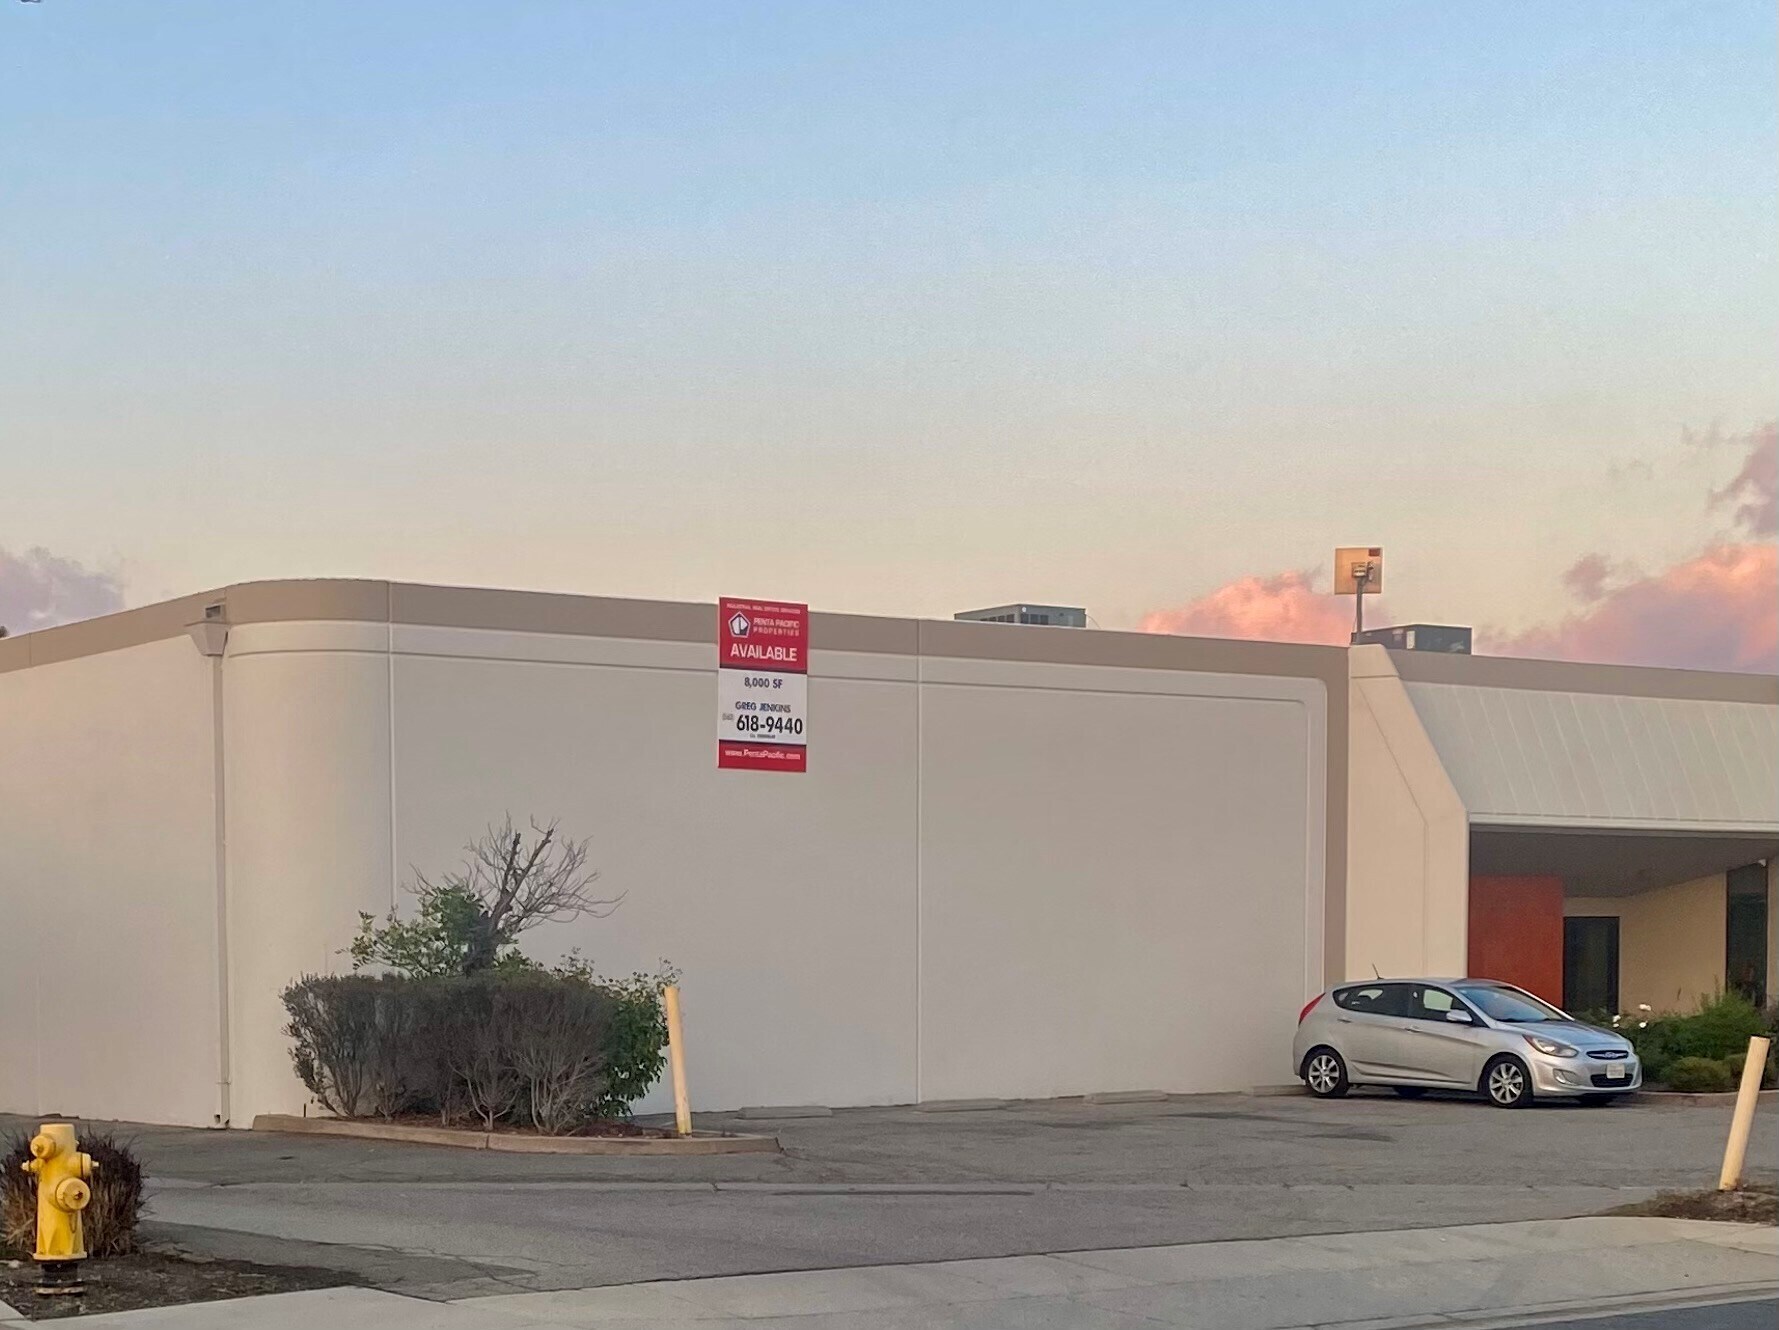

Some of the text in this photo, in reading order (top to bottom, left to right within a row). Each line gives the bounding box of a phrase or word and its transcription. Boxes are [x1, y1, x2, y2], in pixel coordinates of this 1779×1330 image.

[731, 643, 797, 661] AVAILABLE
[744, 677, 783, 689] 8,000 SF
[735, 701, 791, 713] GREG JENKINS
[736, 716, 803, 735] 618-9440
